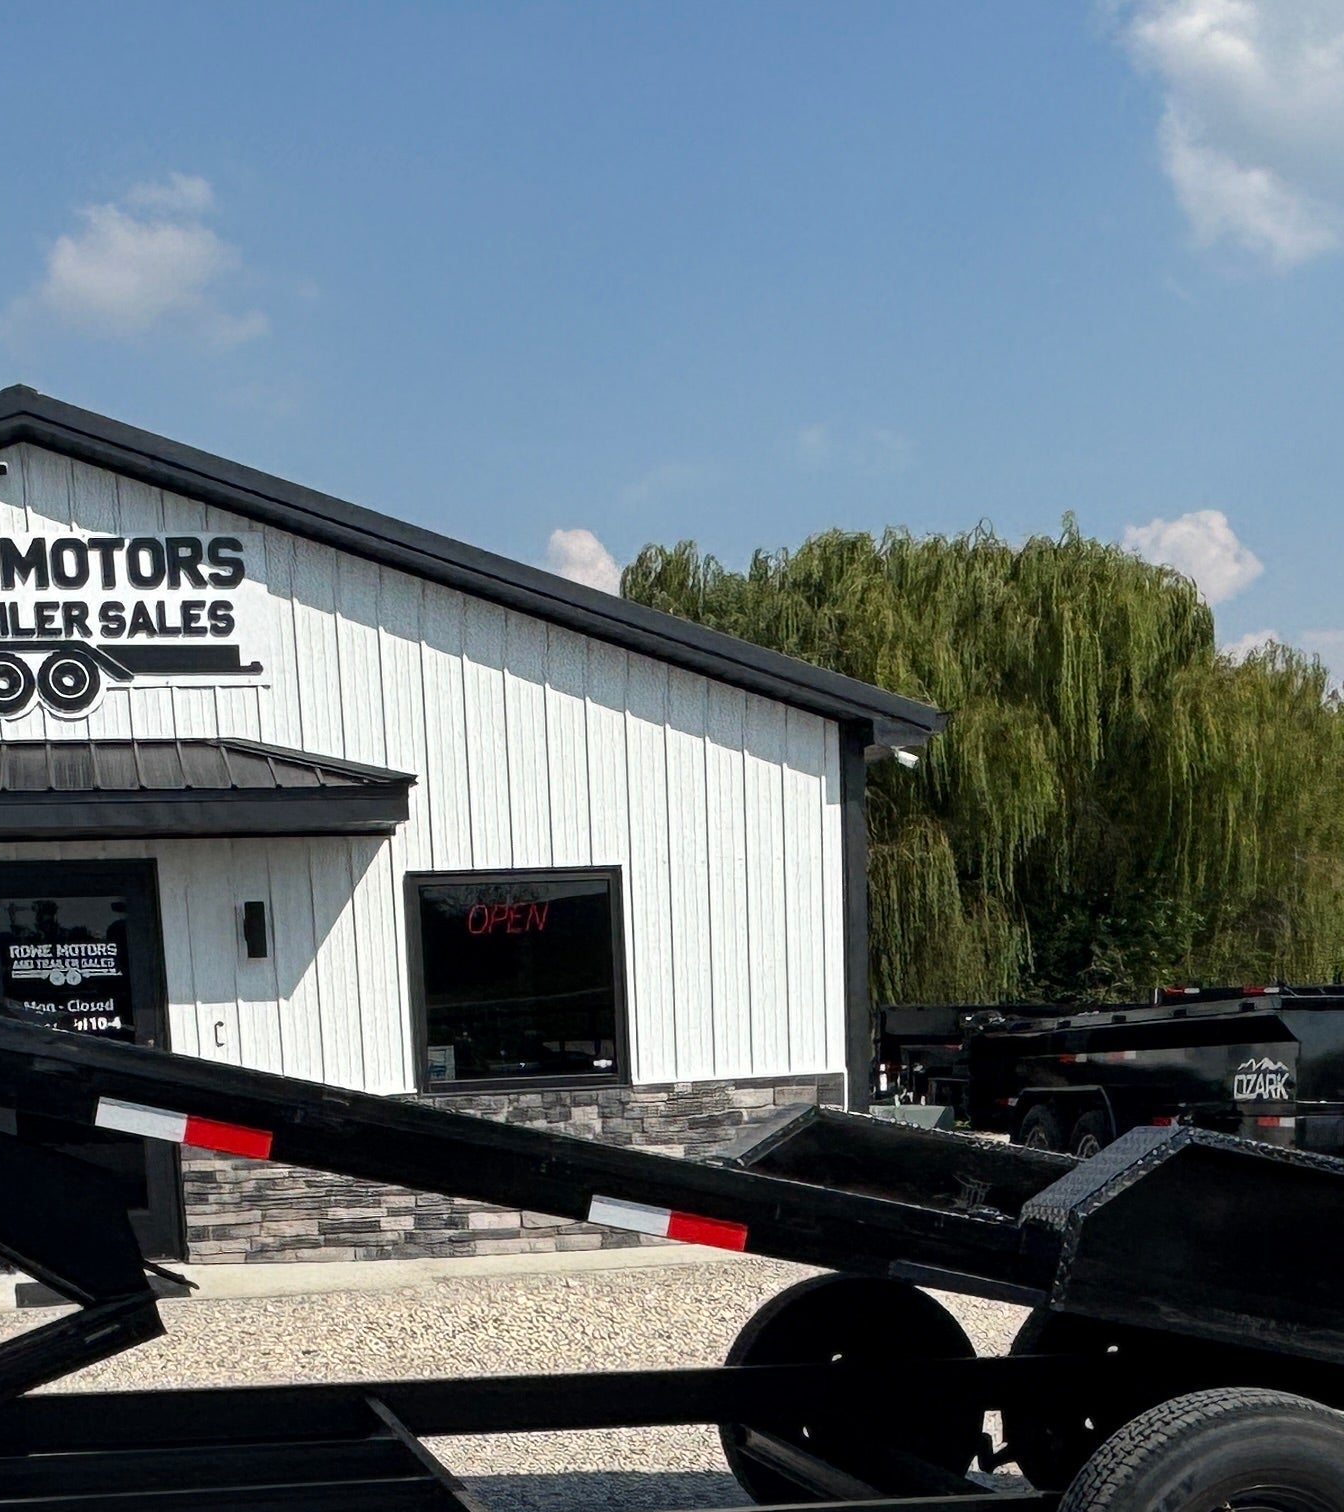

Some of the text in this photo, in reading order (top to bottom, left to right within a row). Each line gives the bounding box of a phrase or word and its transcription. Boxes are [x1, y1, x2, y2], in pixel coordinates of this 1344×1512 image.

[99, 599, 236, 639] SALES
[467, 901, 550, 935] OPEN
[9, 943, 118, 958] ROWE MOTORS
[67, 998, 115, 1013] Closed
[1233, 1071, 1290, 1101] OZARK
